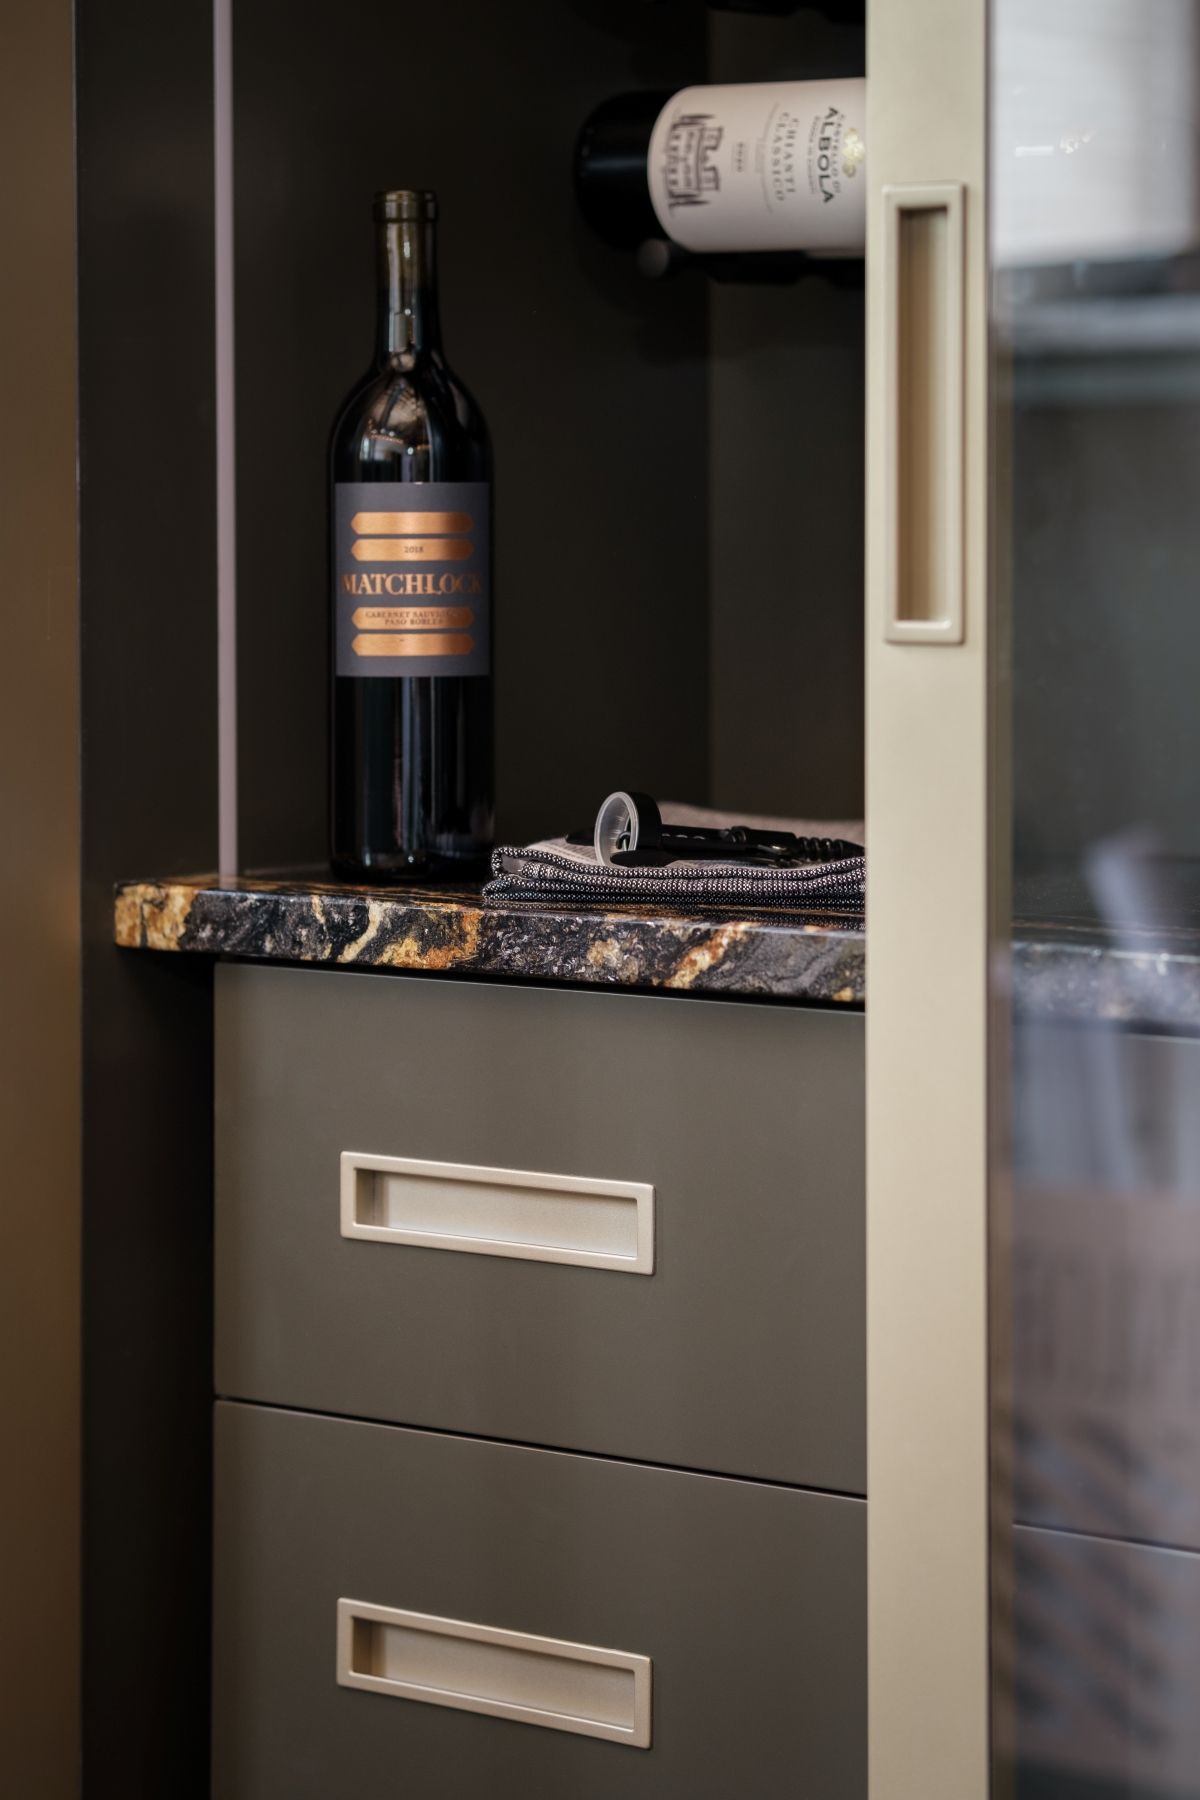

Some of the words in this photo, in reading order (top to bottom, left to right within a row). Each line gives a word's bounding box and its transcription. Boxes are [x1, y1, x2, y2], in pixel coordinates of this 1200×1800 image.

[773, 113, 789, 201] CLASSICO
[784, 118, 799, 192] CHIANTI
[818, 107, 838, 203] ALBOLA
[341, 572, 481, 596] MATCHLOCK
